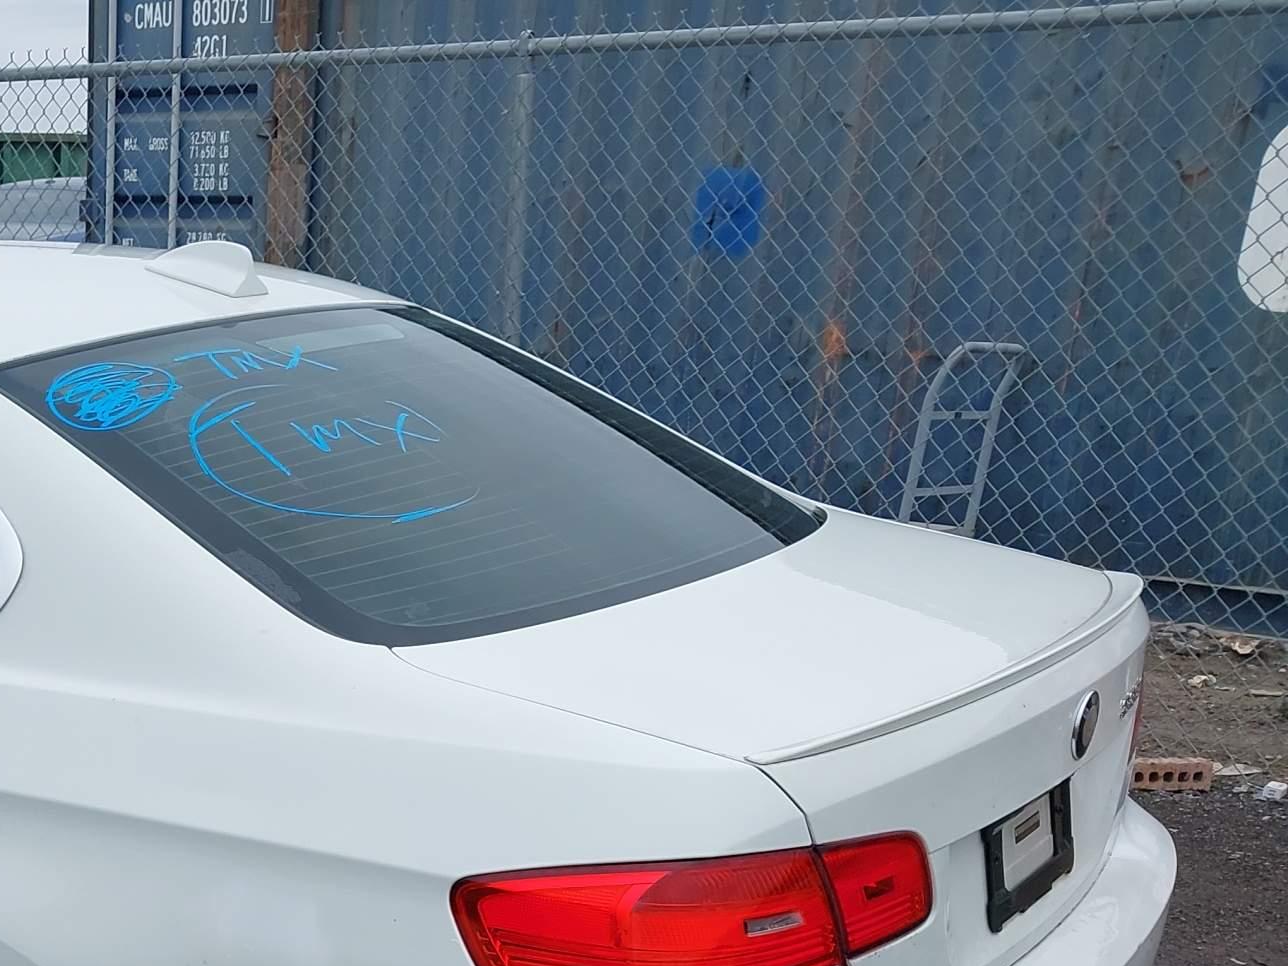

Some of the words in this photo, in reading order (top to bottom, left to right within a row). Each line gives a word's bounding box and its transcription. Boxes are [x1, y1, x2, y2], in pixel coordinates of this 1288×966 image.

[134, 1, 172, 29] CMAU
[192, 0, 248, 27] 803073
[193, 34, 227, 59] 42G1
